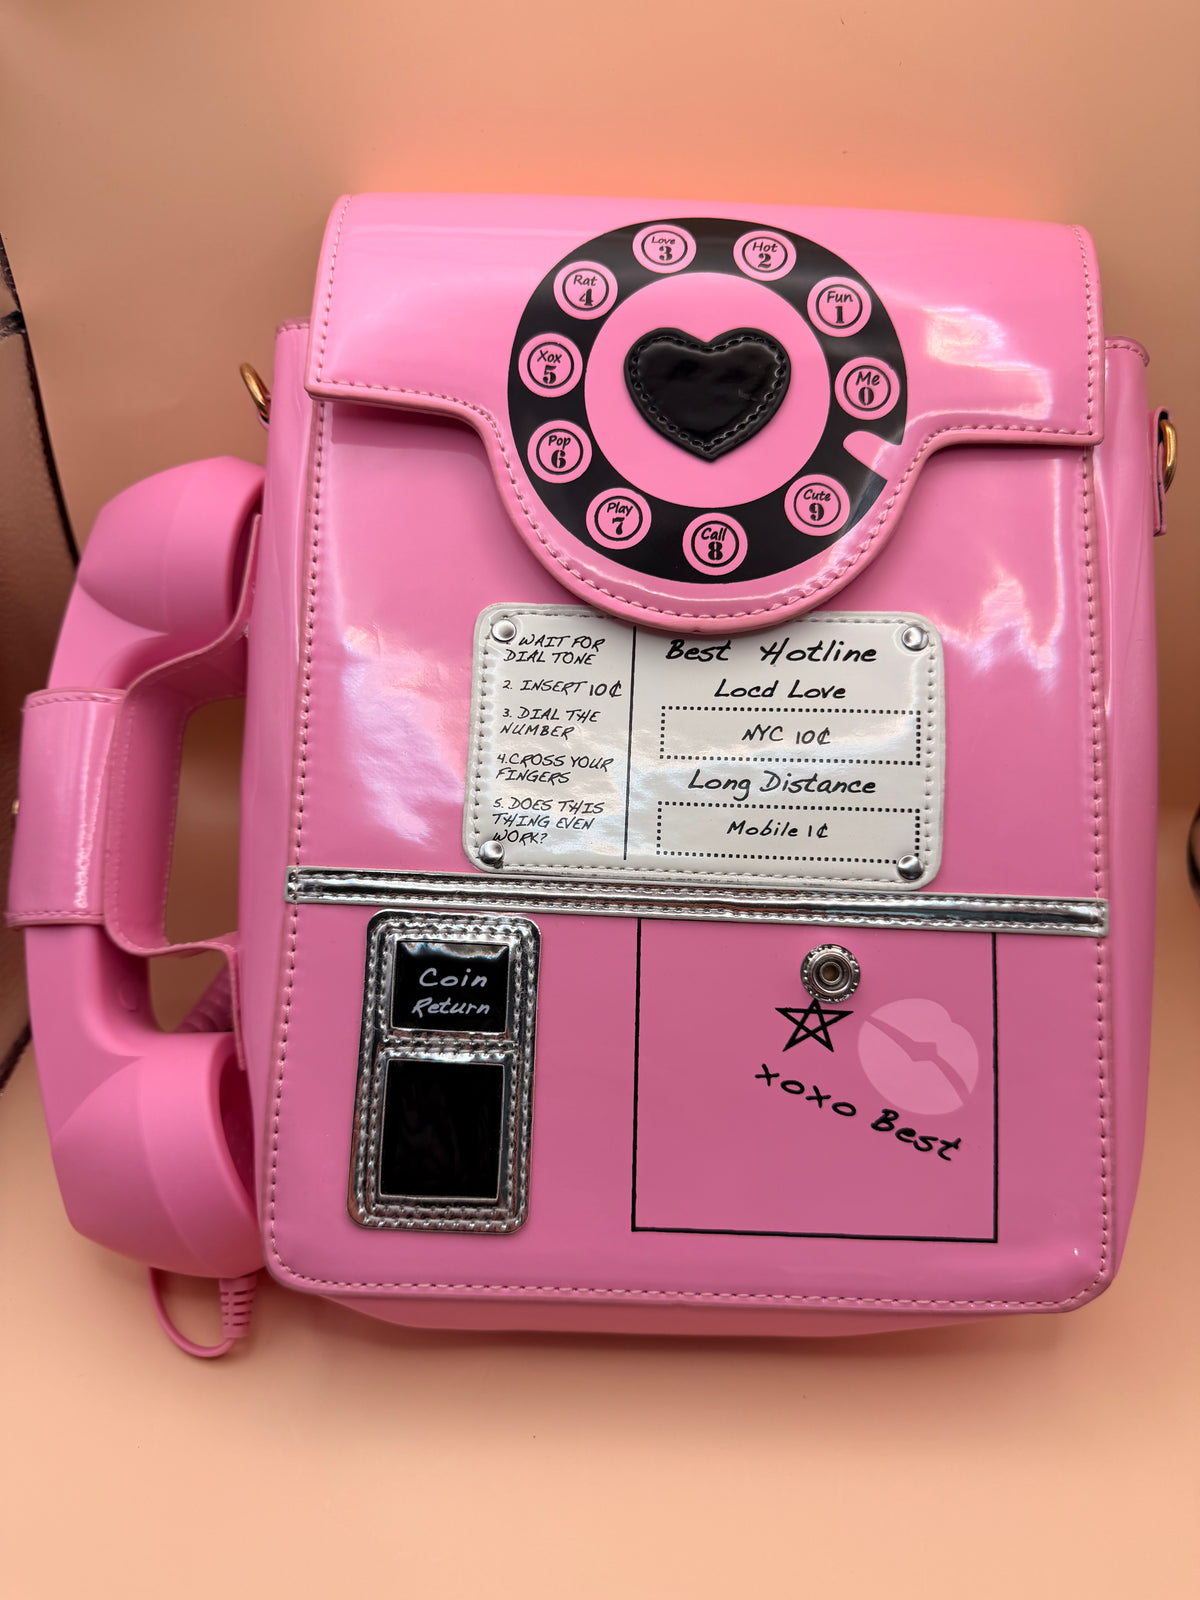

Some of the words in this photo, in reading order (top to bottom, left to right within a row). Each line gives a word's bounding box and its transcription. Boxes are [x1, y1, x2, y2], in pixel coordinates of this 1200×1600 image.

[651, 236, 676, 245] Love
[752, 242, 778, 252] Hot
[659, 246, 673, 261] 3
[758, 253, 772, 268] 2
[573, 274, 597, 287] Rat
[579, 289, 594, 306] 4
[827, 291, 853, 304] Fun
[835, 306, 844, 324] 1
[537, 350, 562, 363] Xox
[543, 365, 556, 384] 5
[856, 372, 880, 386] Me
[859, 387, 873, 405] 0
[548, 435, 571, 449] Pop
[551, 450, 566, 467] 6
[803, 489, 831, 502] Cute
[607, 502, 633, 517] Play
[809, 502, 824, 521] 9
[612, 517, 625, 534] 7
[701, 527, 726, 541] Call
[708, 541, 723, 560] 8
[519, 634, 570, 647] WAIT
[571, 637, 605, 652] FOR
[666, 639, 732, 662] Best
[760, 638, 877, 665] Hotline
[504, 649, 545, 663] DIAL
[552, 652, 596, 665] TONE
[503, 680, 512, 689] 2.
[520, 680, 587, 695] INSERT
[787, 680, 846, 699] Love
[503, 709, 512, 718] 3.
[518, 707, 559, 720] DIAL
[566, 709, 600, 723] THE
[500, 723, 575, 740] NUMBER
[742, 724, 783, 742] NYC
[571, 756, 614, 772] YOUR
[496, 767, 570, 785] FINGERS
[688, 769, 750, 801] Long
[759, 771, 876, 794] Distance
[493, 798, 503, 808] 5.
[508, 797, 553, 811] DOES
[559, 801, 605, 814] THIS
[493, 814, 550, 828] THING
[556, 817, 594, 829] EVEN
[727, 820, 798, 838] Mobile
[492, 830, 548, 844] WORK?
[419, 967, 487, 988] Coin
[412, 998, 490, 1017] Return
[870, 1109, 961, 1161] Best
